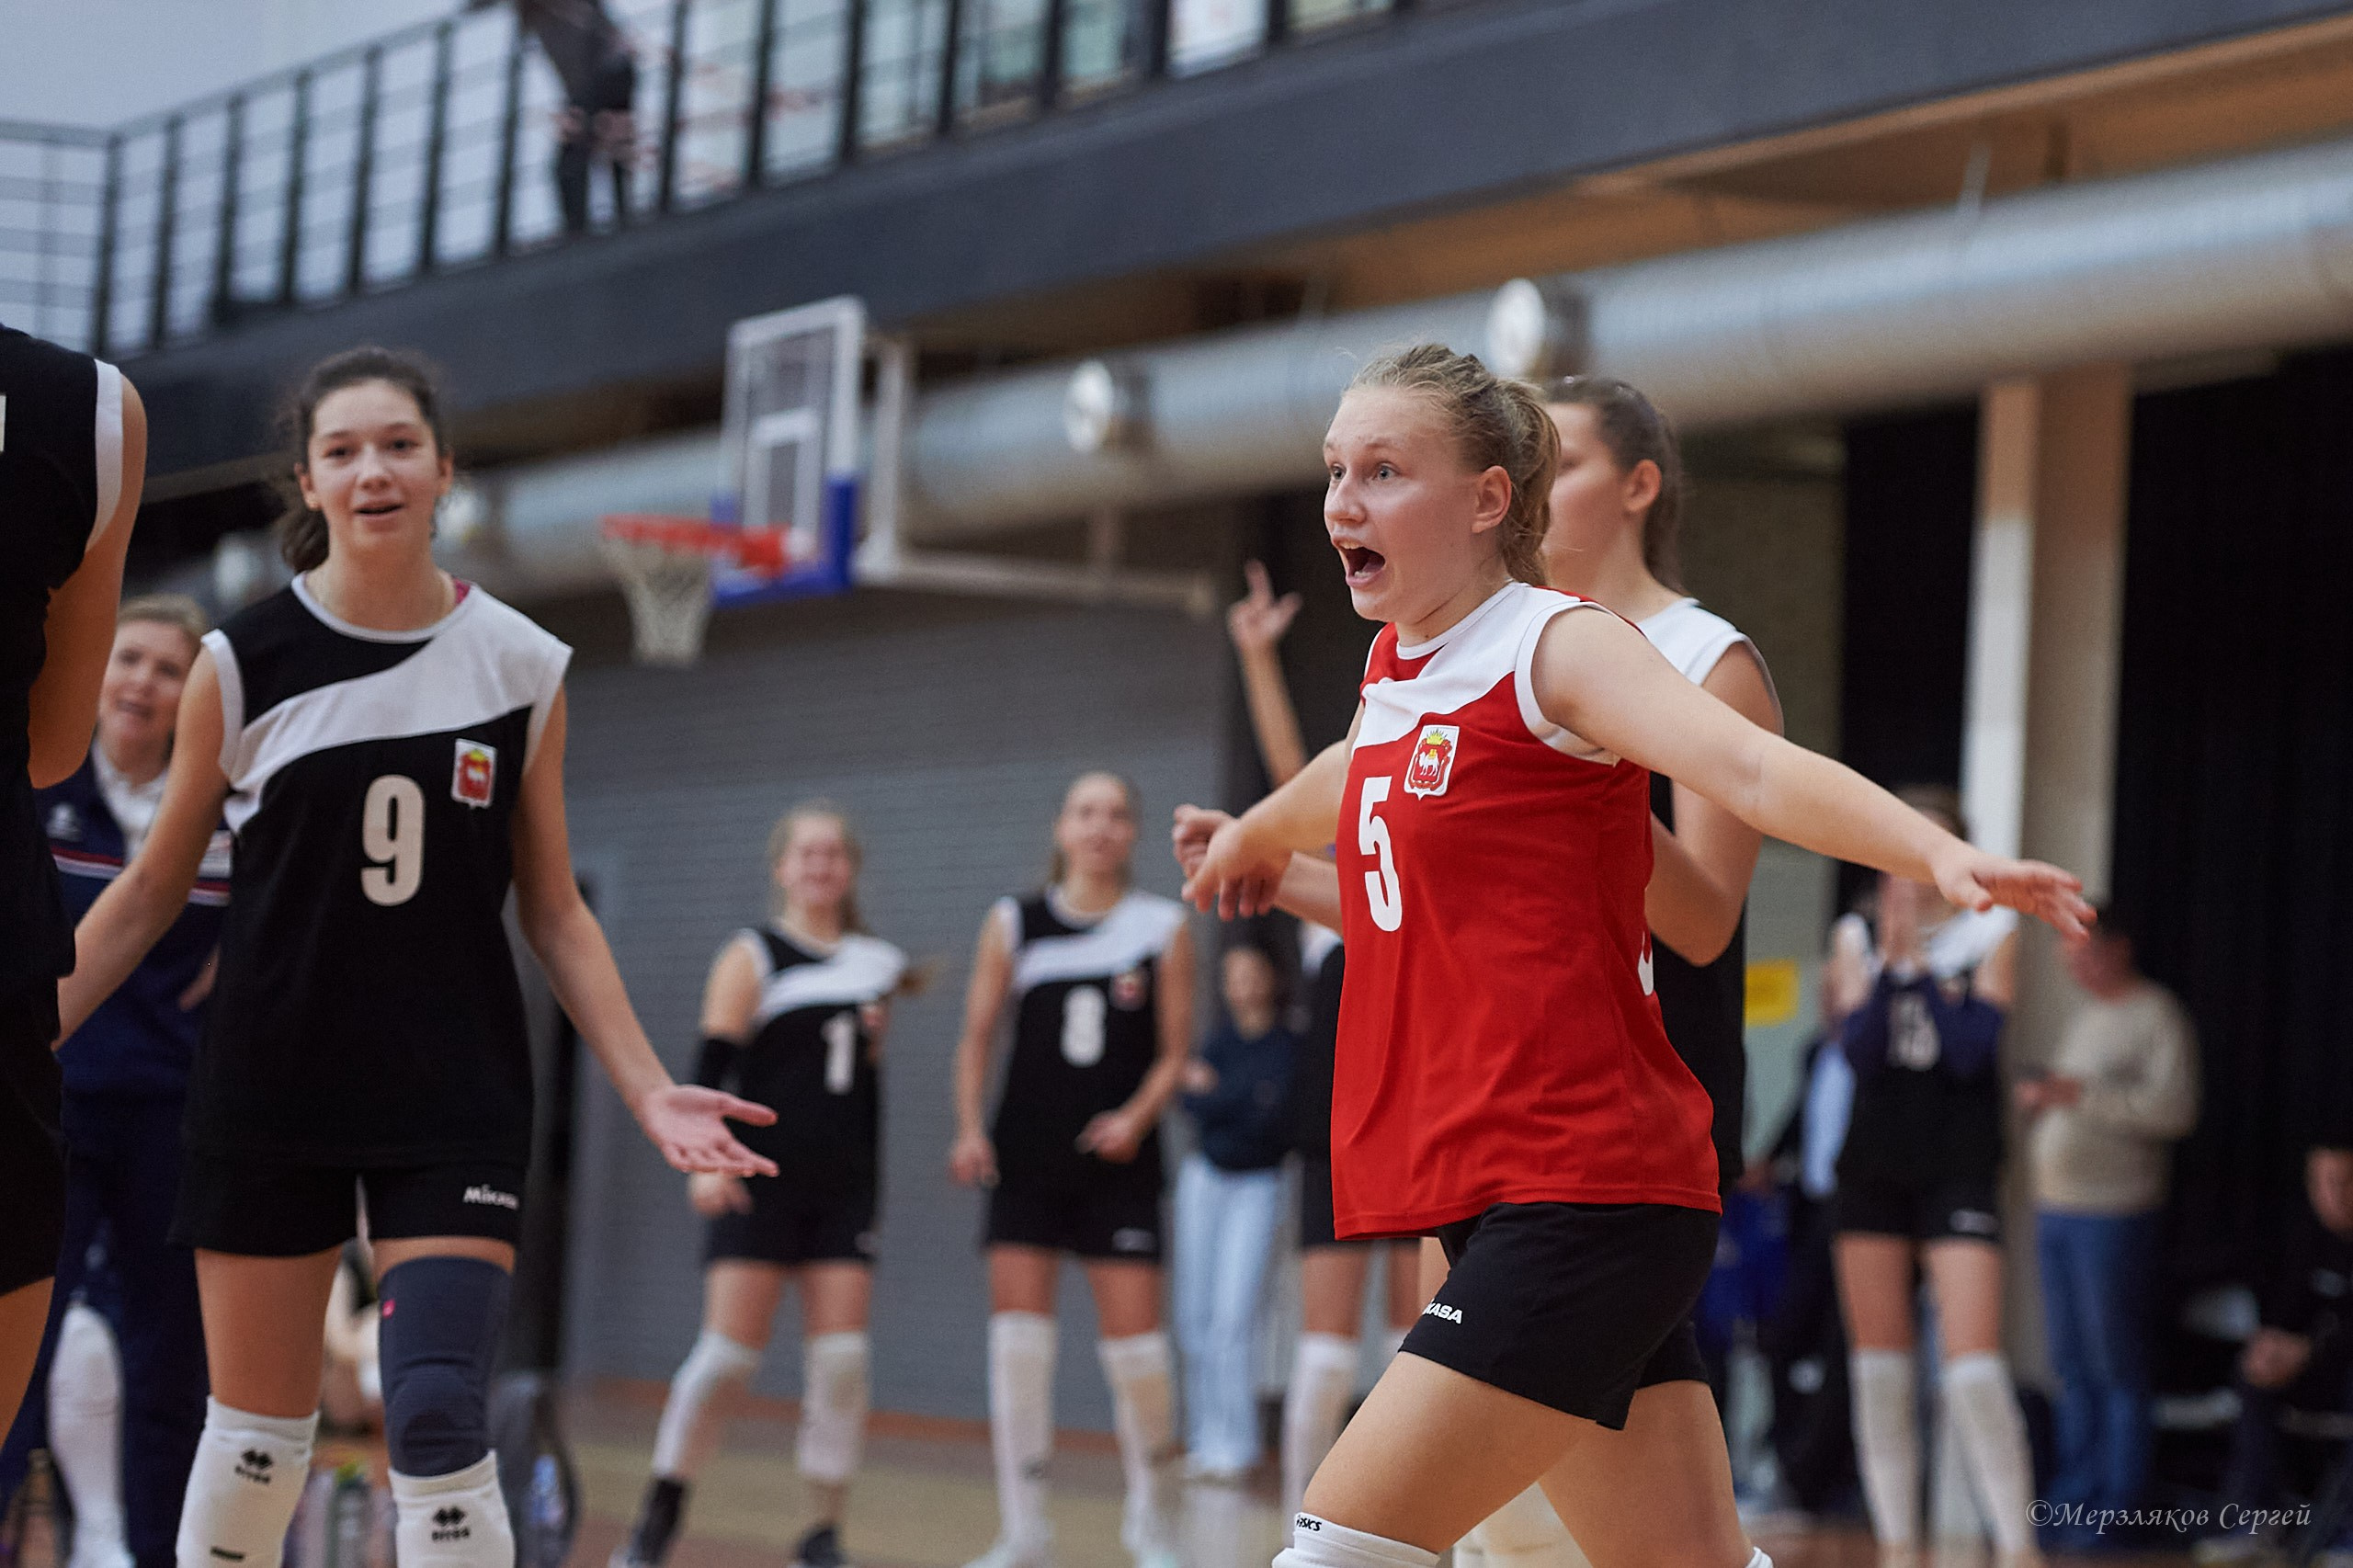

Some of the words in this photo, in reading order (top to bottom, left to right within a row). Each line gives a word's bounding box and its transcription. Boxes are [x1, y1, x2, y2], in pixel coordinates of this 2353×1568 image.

[361, 774, 425, 906] 9
[1358, 776, 1403, 932] 5
[821, 1012, 855, 1095] 1
